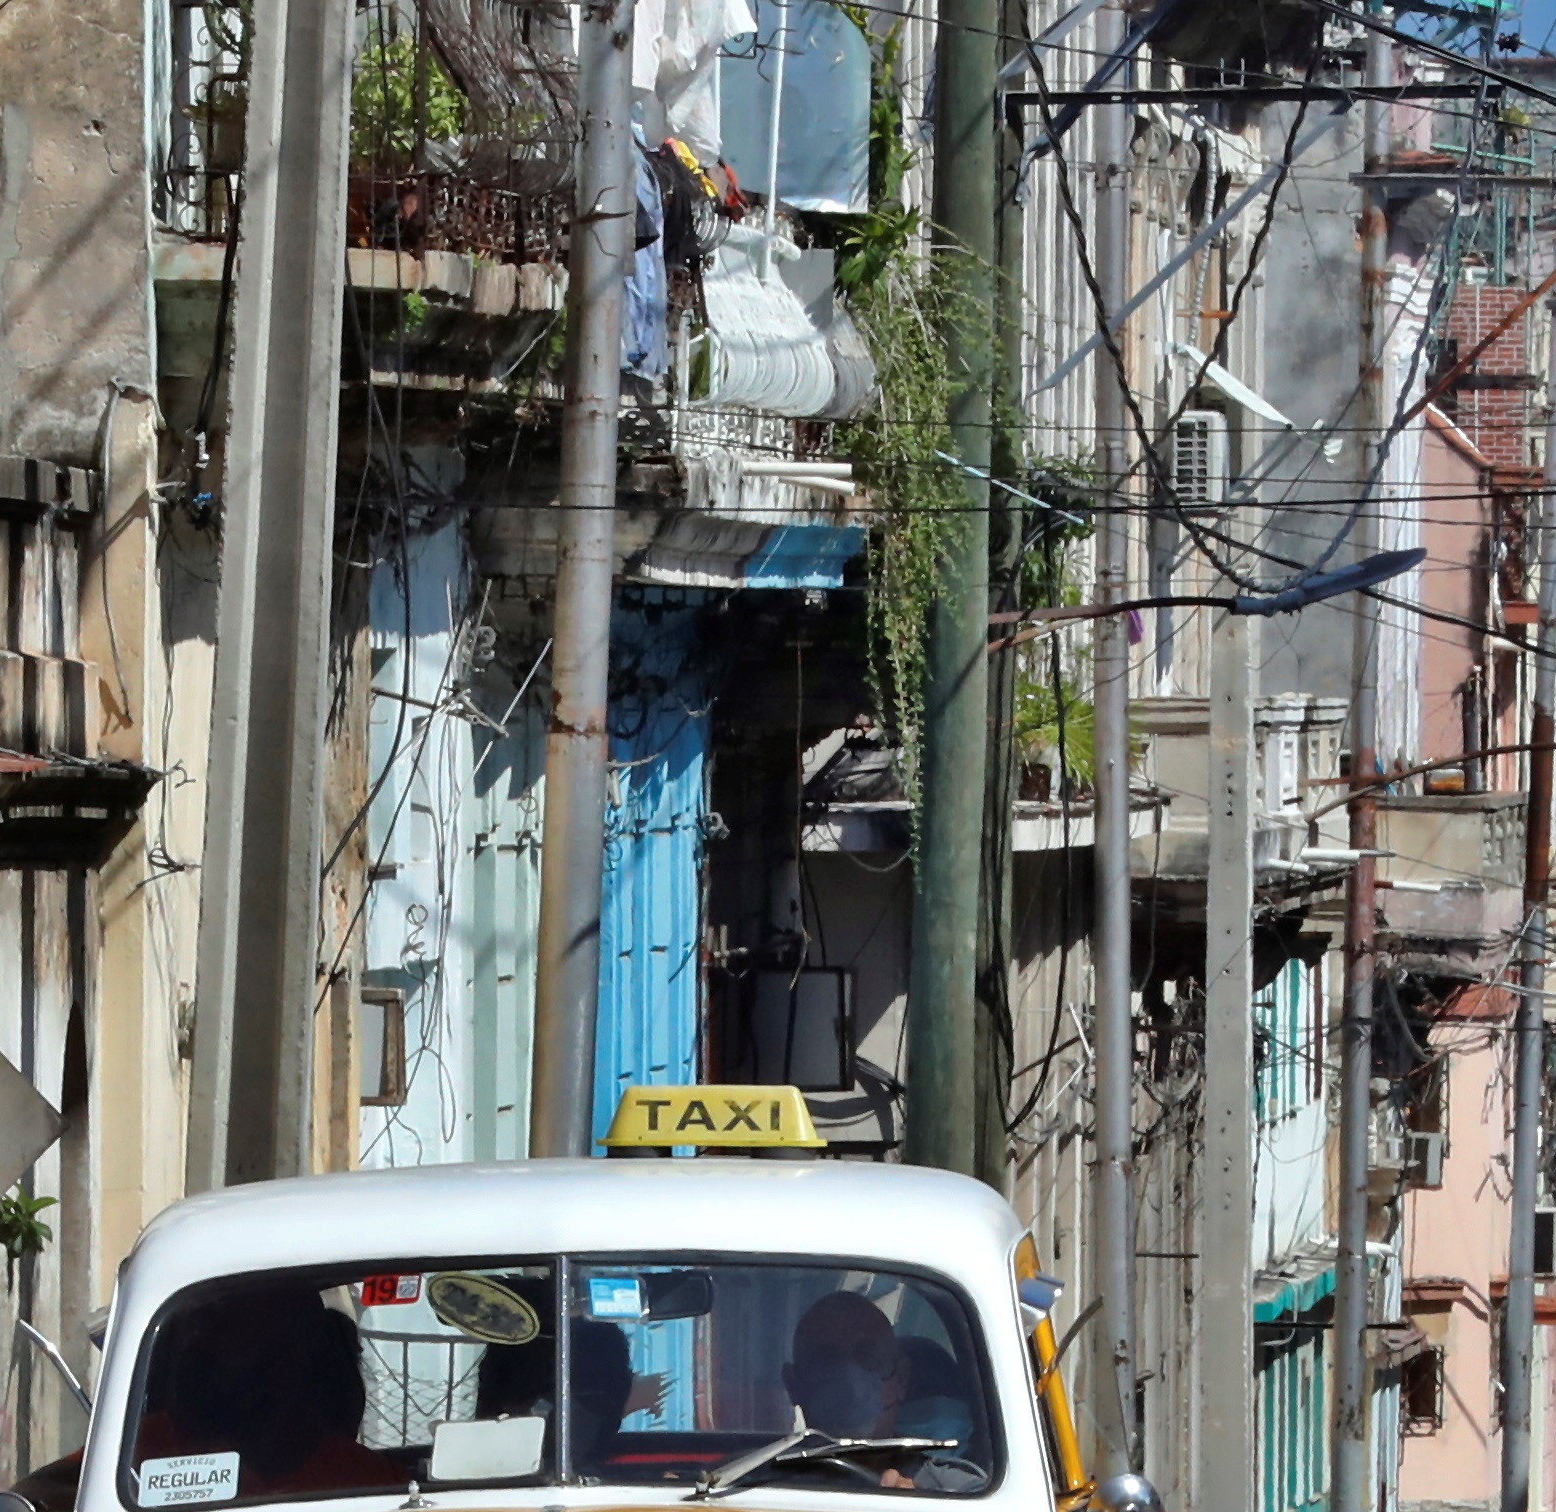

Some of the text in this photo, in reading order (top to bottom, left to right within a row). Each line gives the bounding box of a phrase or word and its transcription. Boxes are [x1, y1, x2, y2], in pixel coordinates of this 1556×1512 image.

[635, 1099, 781, 1132] TAXI
[364, 1276, 397, 1303] 19
[168, 1458, 217, 1469] SERVICIO
[148, 1469, 232, 1491] REGULAR
